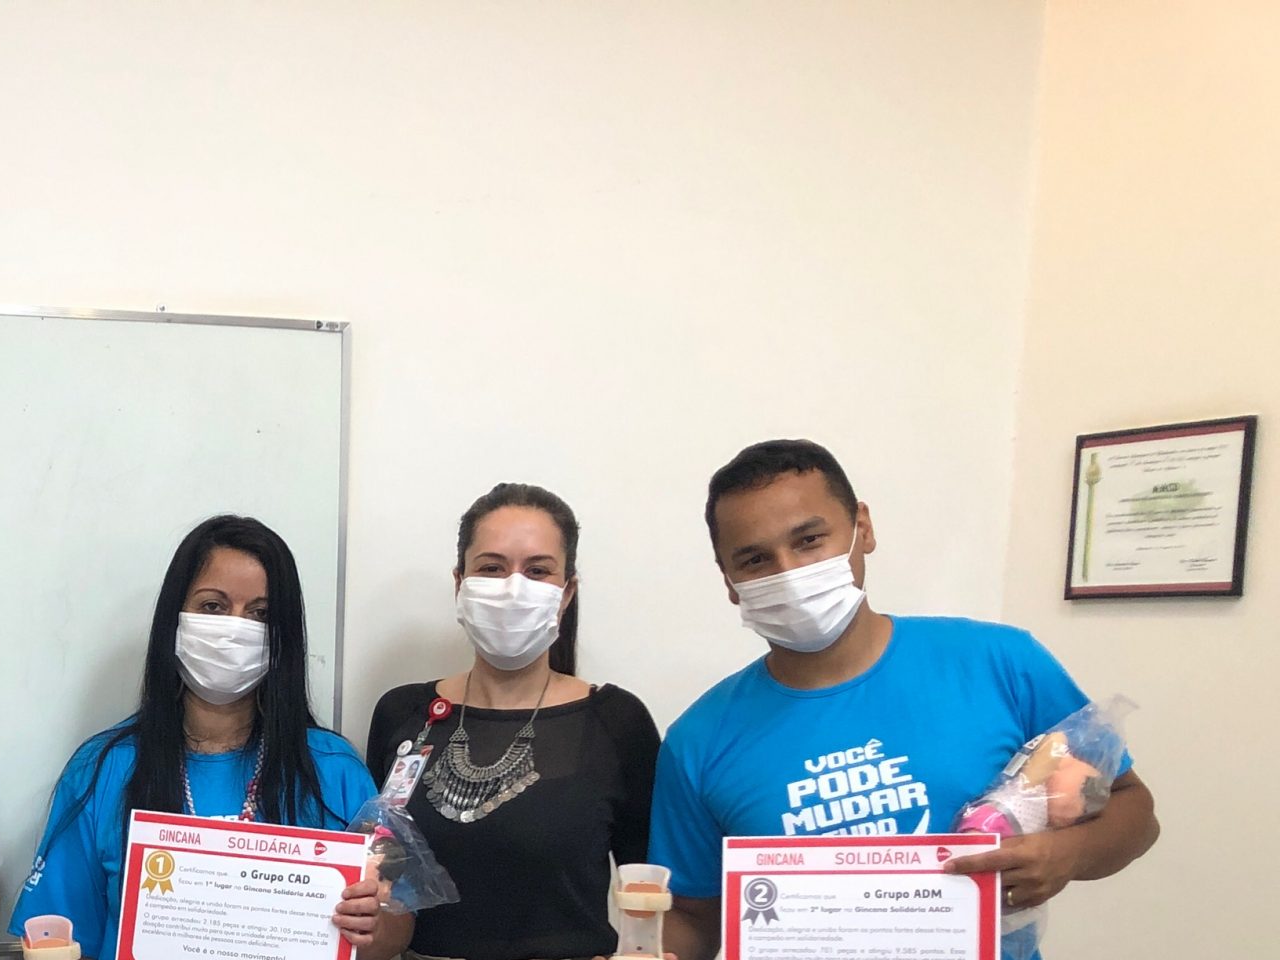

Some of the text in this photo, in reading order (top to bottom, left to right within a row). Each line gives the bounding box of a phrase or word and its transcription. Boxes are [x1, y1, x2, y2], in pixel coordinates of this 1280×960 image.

[804, 738, 884, 773] VOCÊ
[787, 756, 912, 808] PODE
[781, 781, 929, 836] MUDAR
[159, 829, 301, 855] GINCANA SOLIDÁRIA
[156, 856, 165, 874] 1
[756, 849, 921, 866] GINCANA SOLIDÁRIA
[240, 870, 247, 878] o
[251, 870, 284, 884] Grupo
[288, 873, 311, 885] CAD
[214, 882, 232, 890] lugar
[243, 885, 271, 894] Gincana
[273, 888, 304, 897] Solidária
[754, 883, 768, 903] 2
[864, 891, 870, 899] o
[875, 889, 909, 901] Grupo
[914, 889, 942, 899] ADM
[183, 944, 200, 953] Você
[217, 949, 238, 957] nosso
